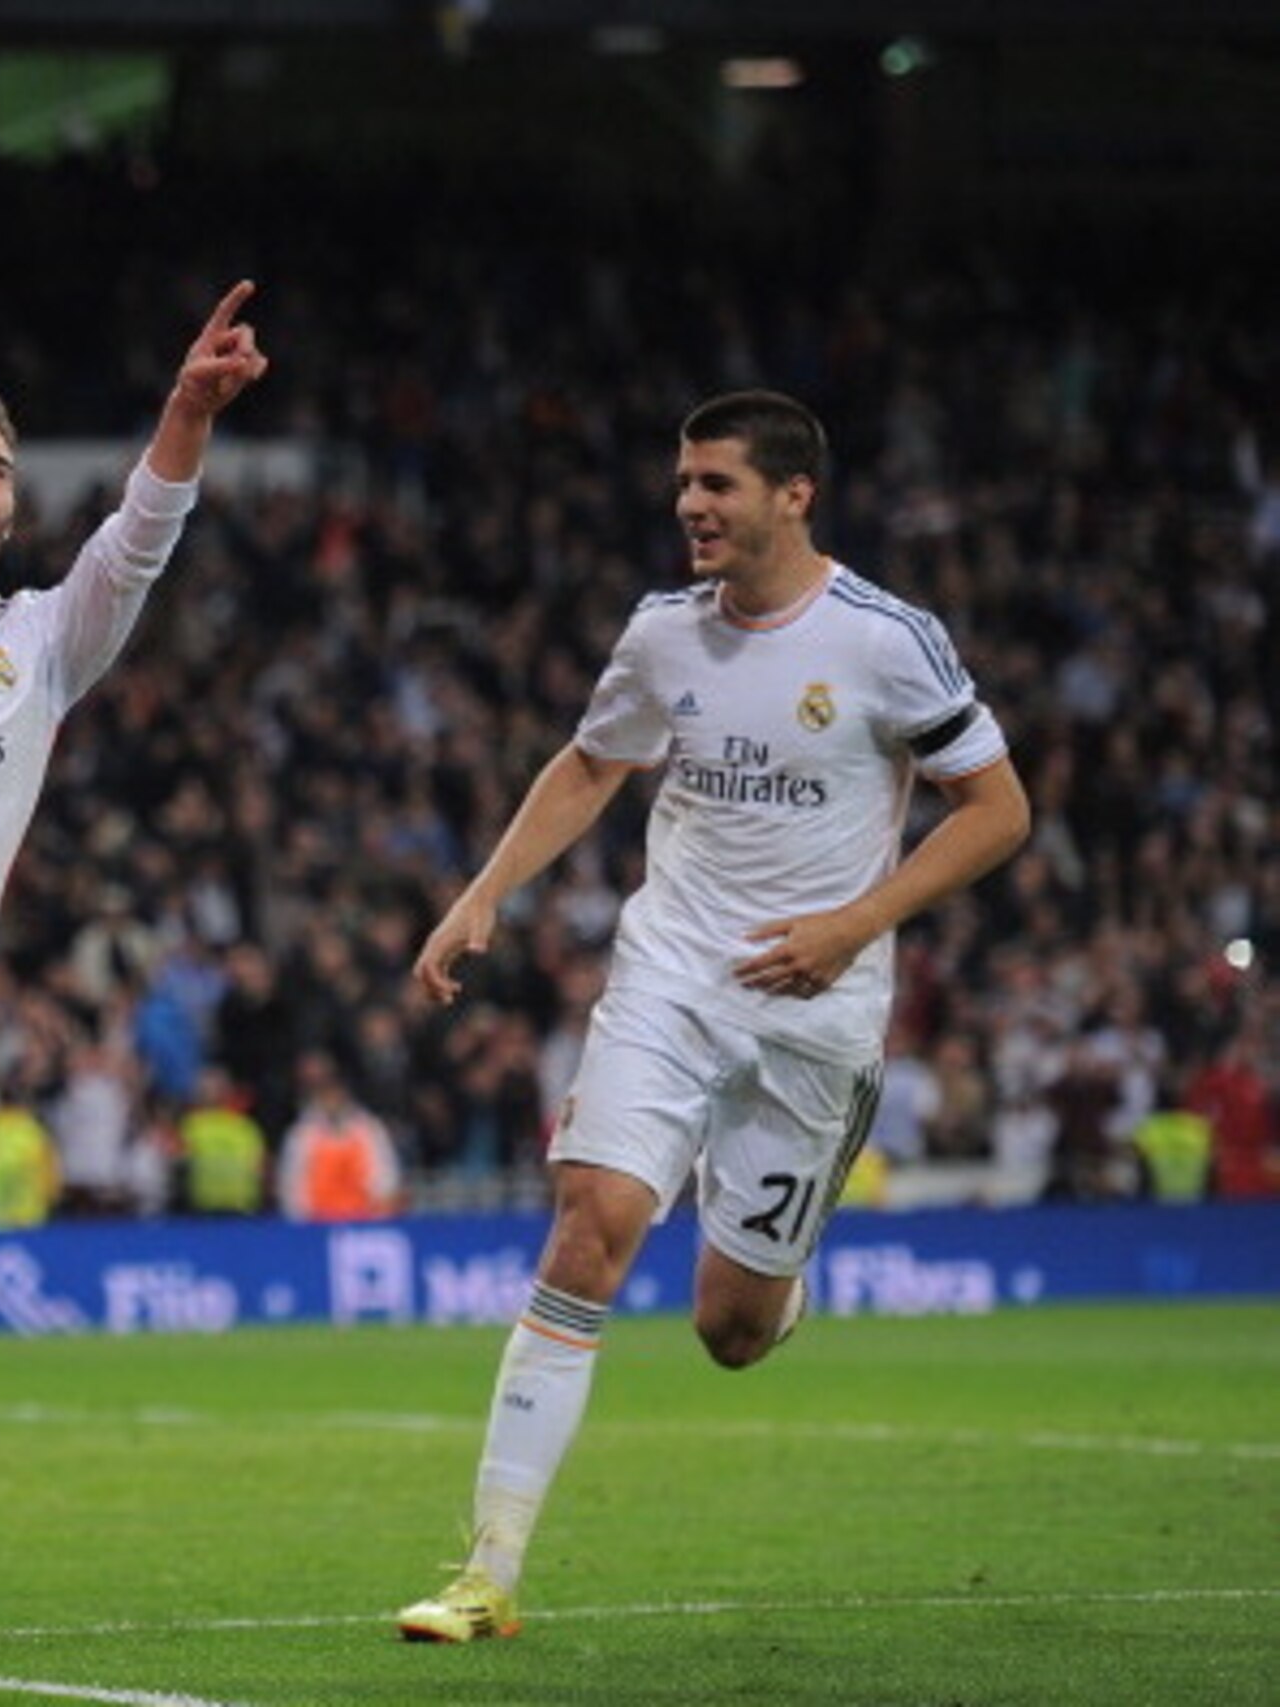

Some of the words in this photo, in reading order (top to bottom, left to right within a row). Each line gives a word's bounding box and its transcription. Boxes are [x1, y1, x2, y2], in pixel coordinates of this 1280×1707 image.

[723, 735, 769, 768] Fly
[679, 756, 827, 808] Emirates
[740, 1172, 815, 1246] 21
